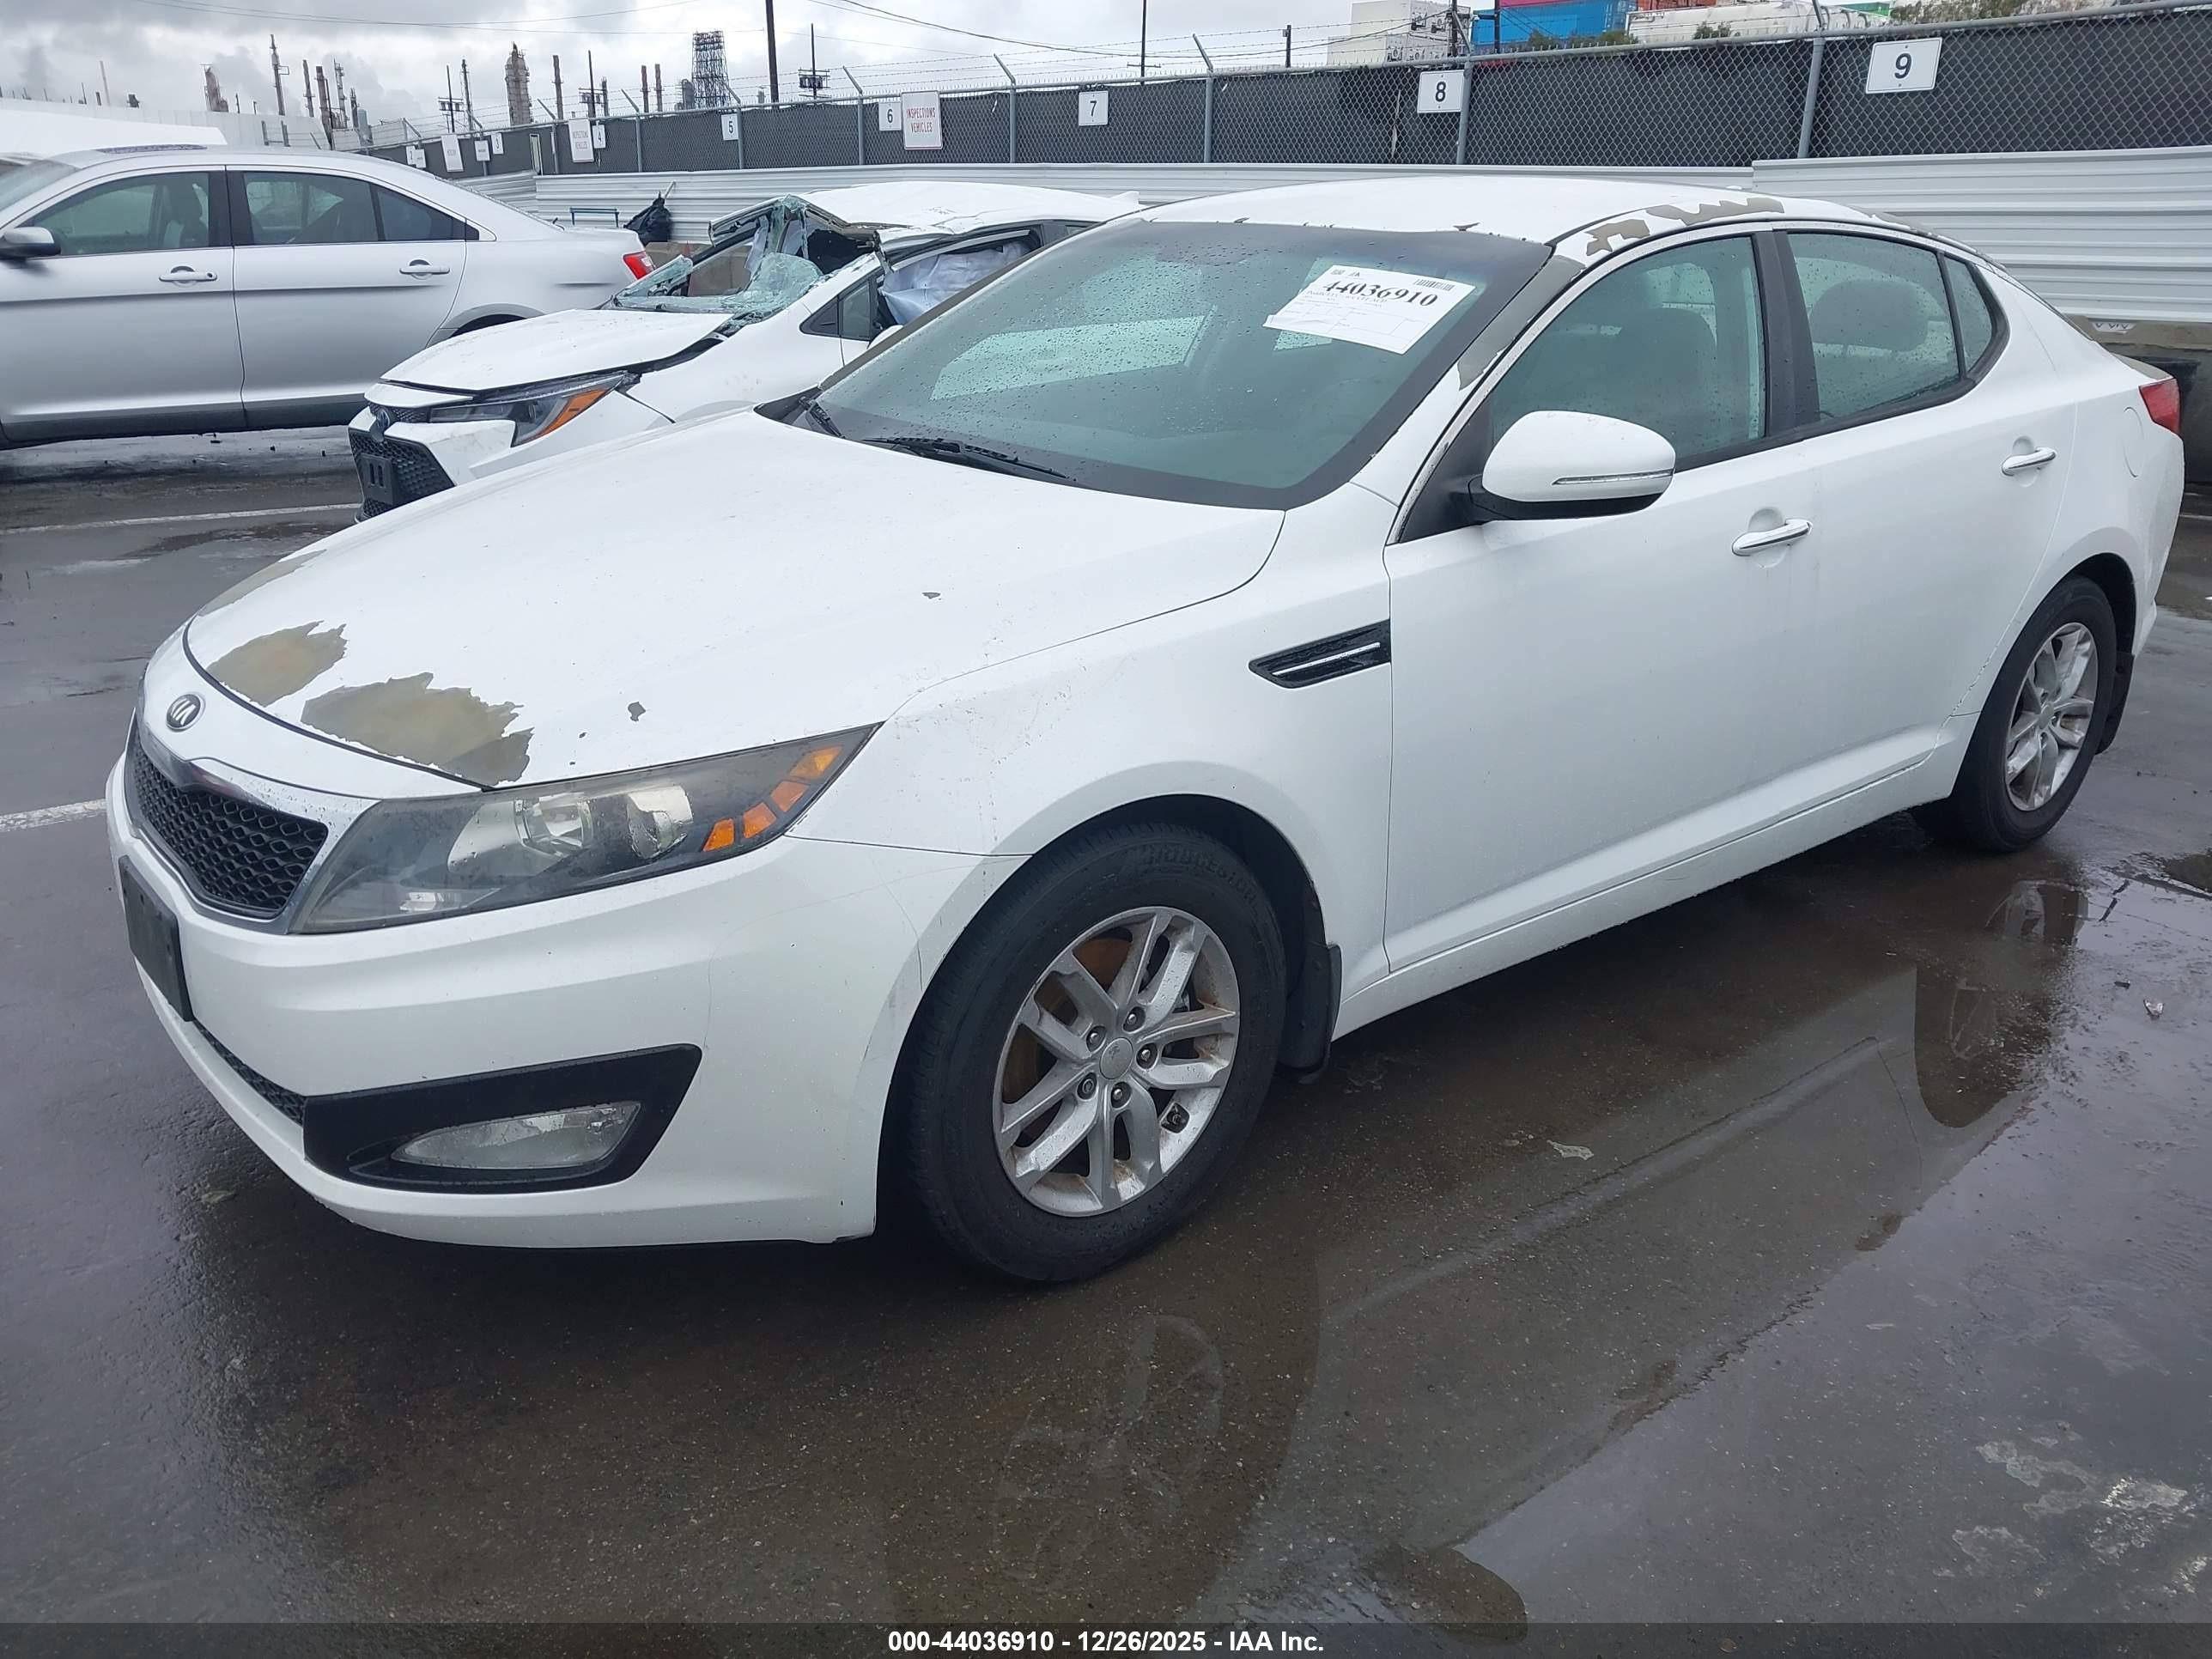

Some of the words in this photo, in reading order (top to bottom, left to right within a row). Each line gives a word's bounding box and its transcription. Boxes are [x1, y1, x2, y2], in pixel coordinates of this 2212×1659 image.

[1894, 52, 1912, 79] 9
[1435, 81, 1447, 102] 8
[887, 108, 894, 124] 6
[906, 107, 936, 119] INSPECTIONS
[1090, 100, 1097, 117] 7
[728, 120, 734, 134] 5
[910, 122, 933, 133] VEHICLES
[597, 130, 603, 143] 4
[1322, 280, 1439, 307] 44036910
